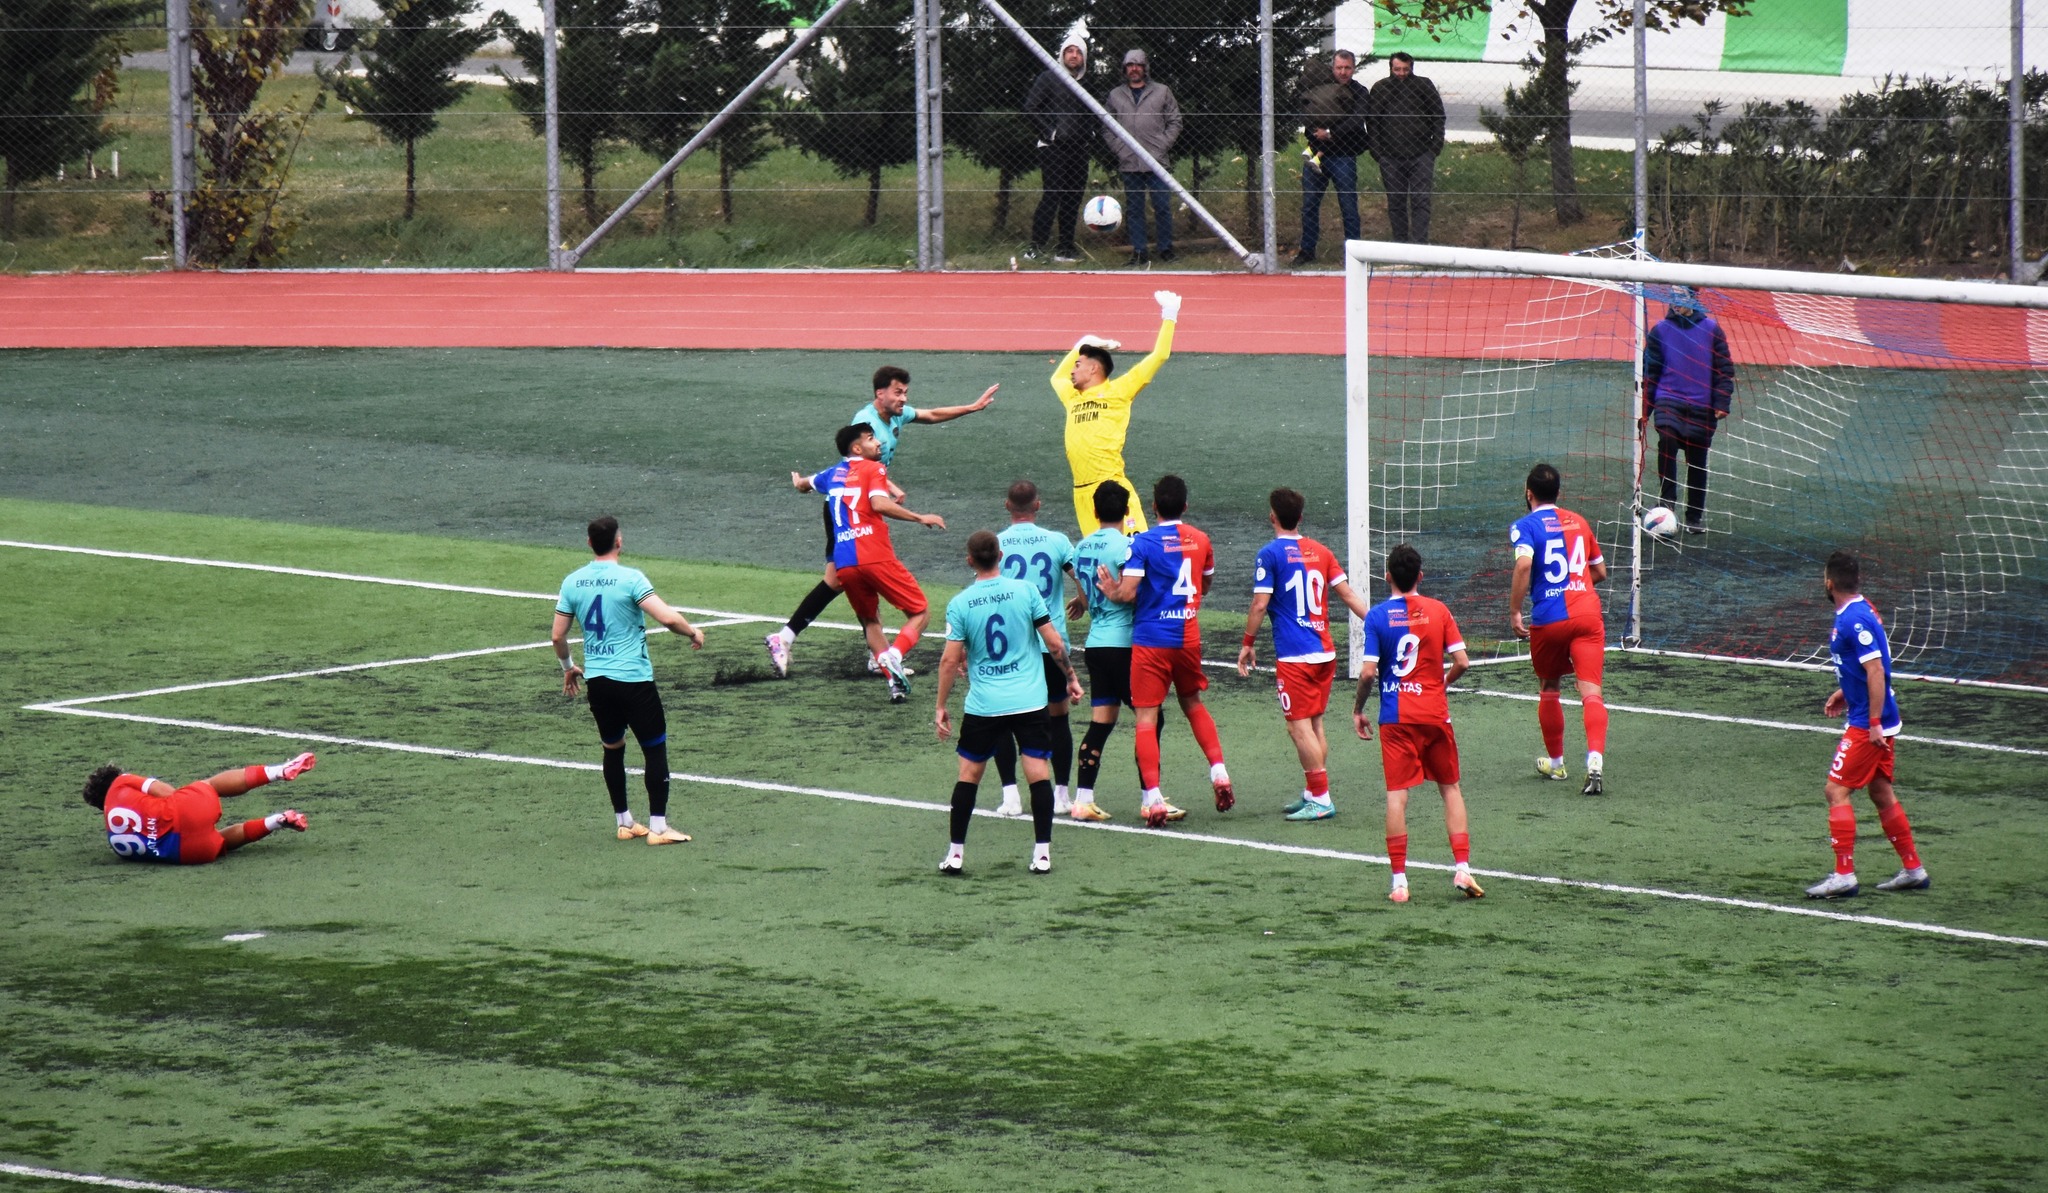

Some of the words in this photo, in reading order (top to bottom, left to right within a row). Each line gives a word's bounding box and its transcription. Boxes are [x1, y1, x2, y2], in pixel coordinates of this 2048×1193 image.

[829, 487, 861, 527] 77
[1004, 552, 1053, 599] 23
[1172, 557, 1197, 604] 4
[1544, 535, 1586, 584] 54
[576, 579, 594, 588] EMEK
[968, 597, 988, 609] EMEK
[1285, 569, 1325, 617] 10
[584, 594, 606, 641] 4
[985, 613, 1008, 661] 6
[978, 662, 1019, 676] SONER
[1391, 633, 1420, 677] 9
[1833, 751, 1847, 772] 5
